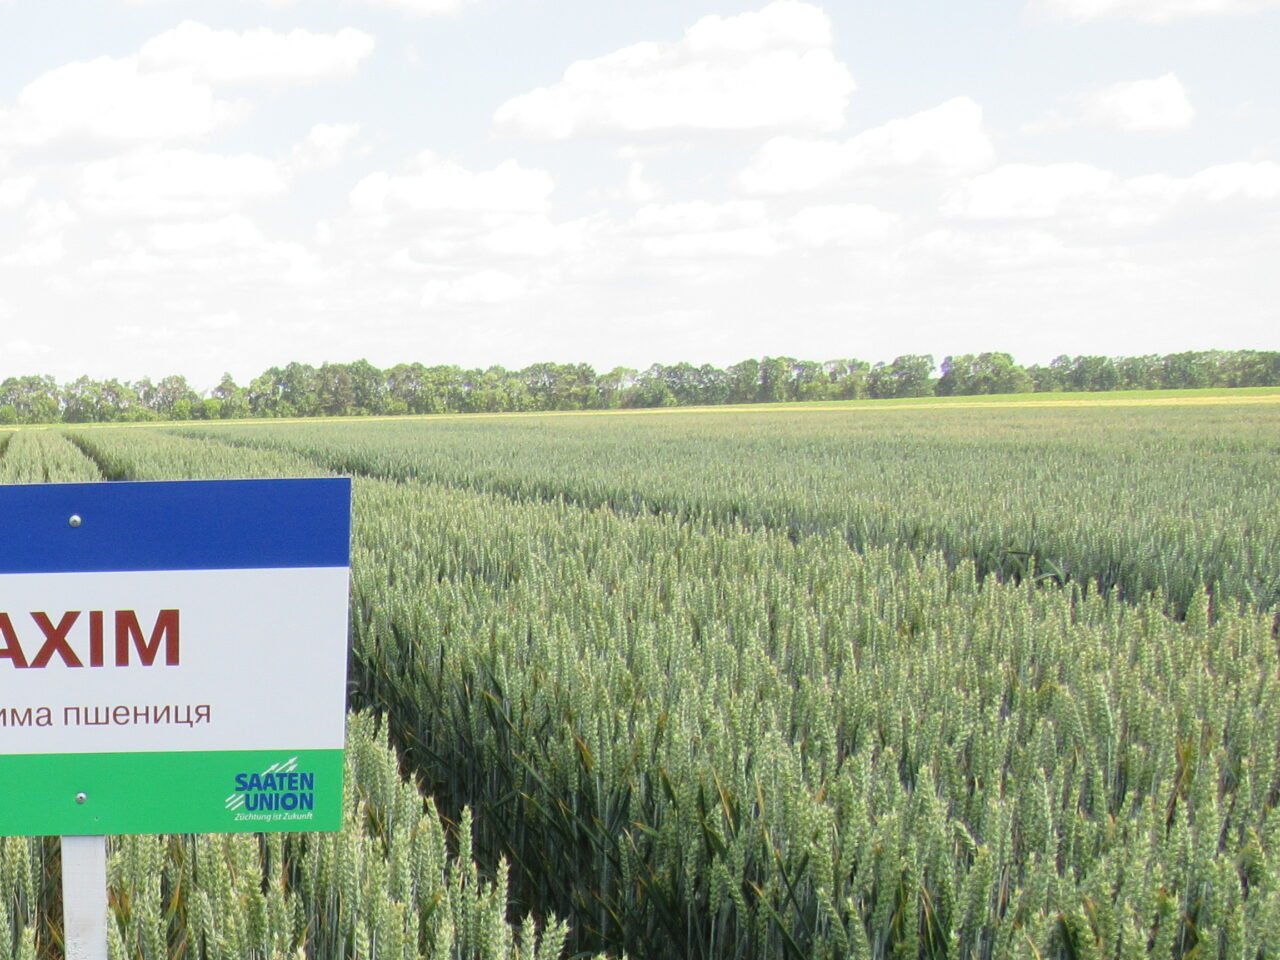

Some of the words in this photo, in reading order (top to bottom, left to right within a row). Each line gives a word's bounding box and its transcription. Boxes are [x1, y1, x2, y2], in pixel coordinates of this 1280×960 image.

[63, 704, 211, 728] пшениця
[234, 772, 314, 791] SAATEN
[244, 792, 314, 811] UNION
[234, 813, 272, 822] Züchtung
[283, 812, 313, 820] Zukunft
